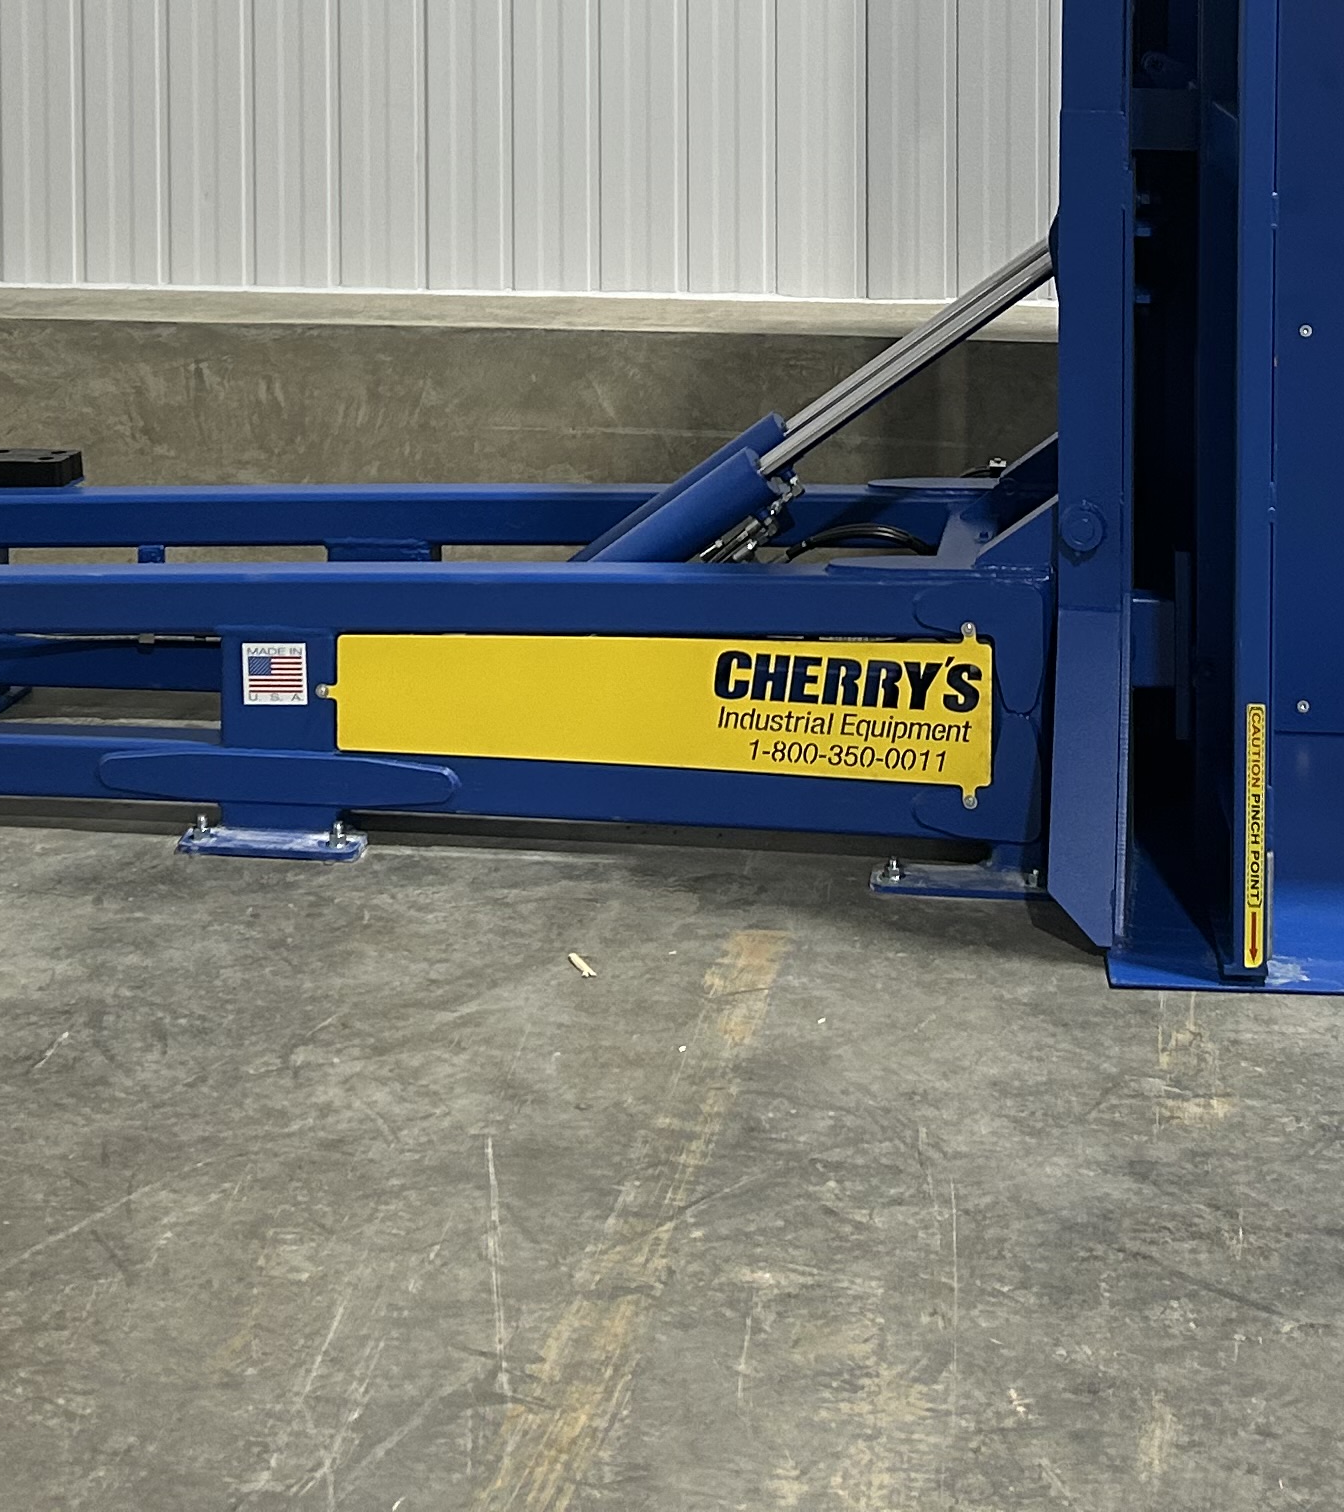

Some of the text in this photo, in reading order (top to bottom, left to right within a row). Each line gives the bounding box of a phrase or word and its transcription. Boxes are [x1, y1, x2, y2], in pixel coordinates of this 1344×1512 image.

[247, 647, 303, 656] MADE IN
[713, 649, 983, 713] CHERRY'S
[717, 705, 973, 744] Industrial Equipment
[748, 739, 947, 773] 1-800-350-0011
[1249, 712, 1262, 901] CAUTION PINCH POINT
